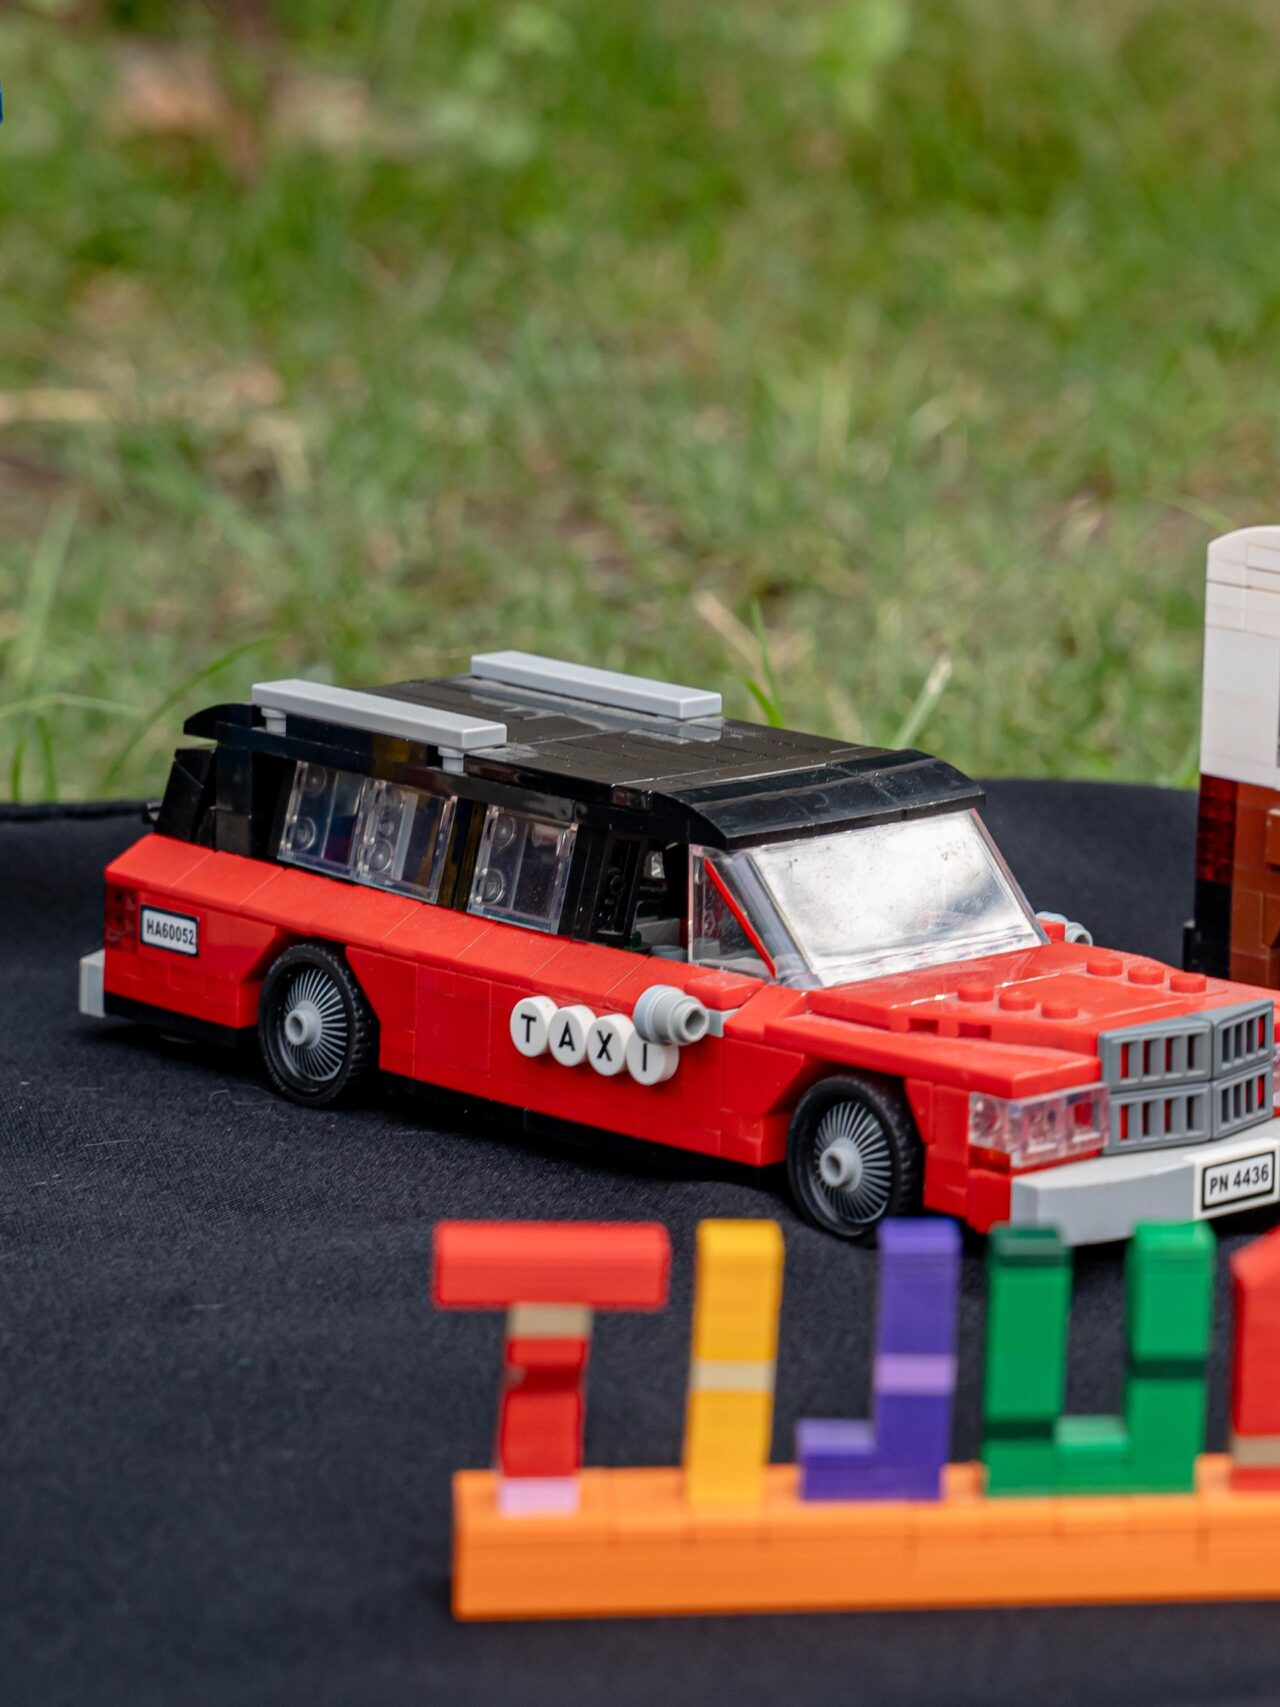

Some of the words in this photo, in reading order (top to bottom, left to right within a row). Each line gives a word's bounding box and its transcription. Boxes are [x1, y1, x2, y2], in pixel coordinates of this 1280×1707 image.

[146, 917, 195, 946] HA60052
[520, 1013, 648, 1072] TAXI
[1209, 1173, 1229, 1195] PN
[1233, 1163, 1269, 1189] 4436
